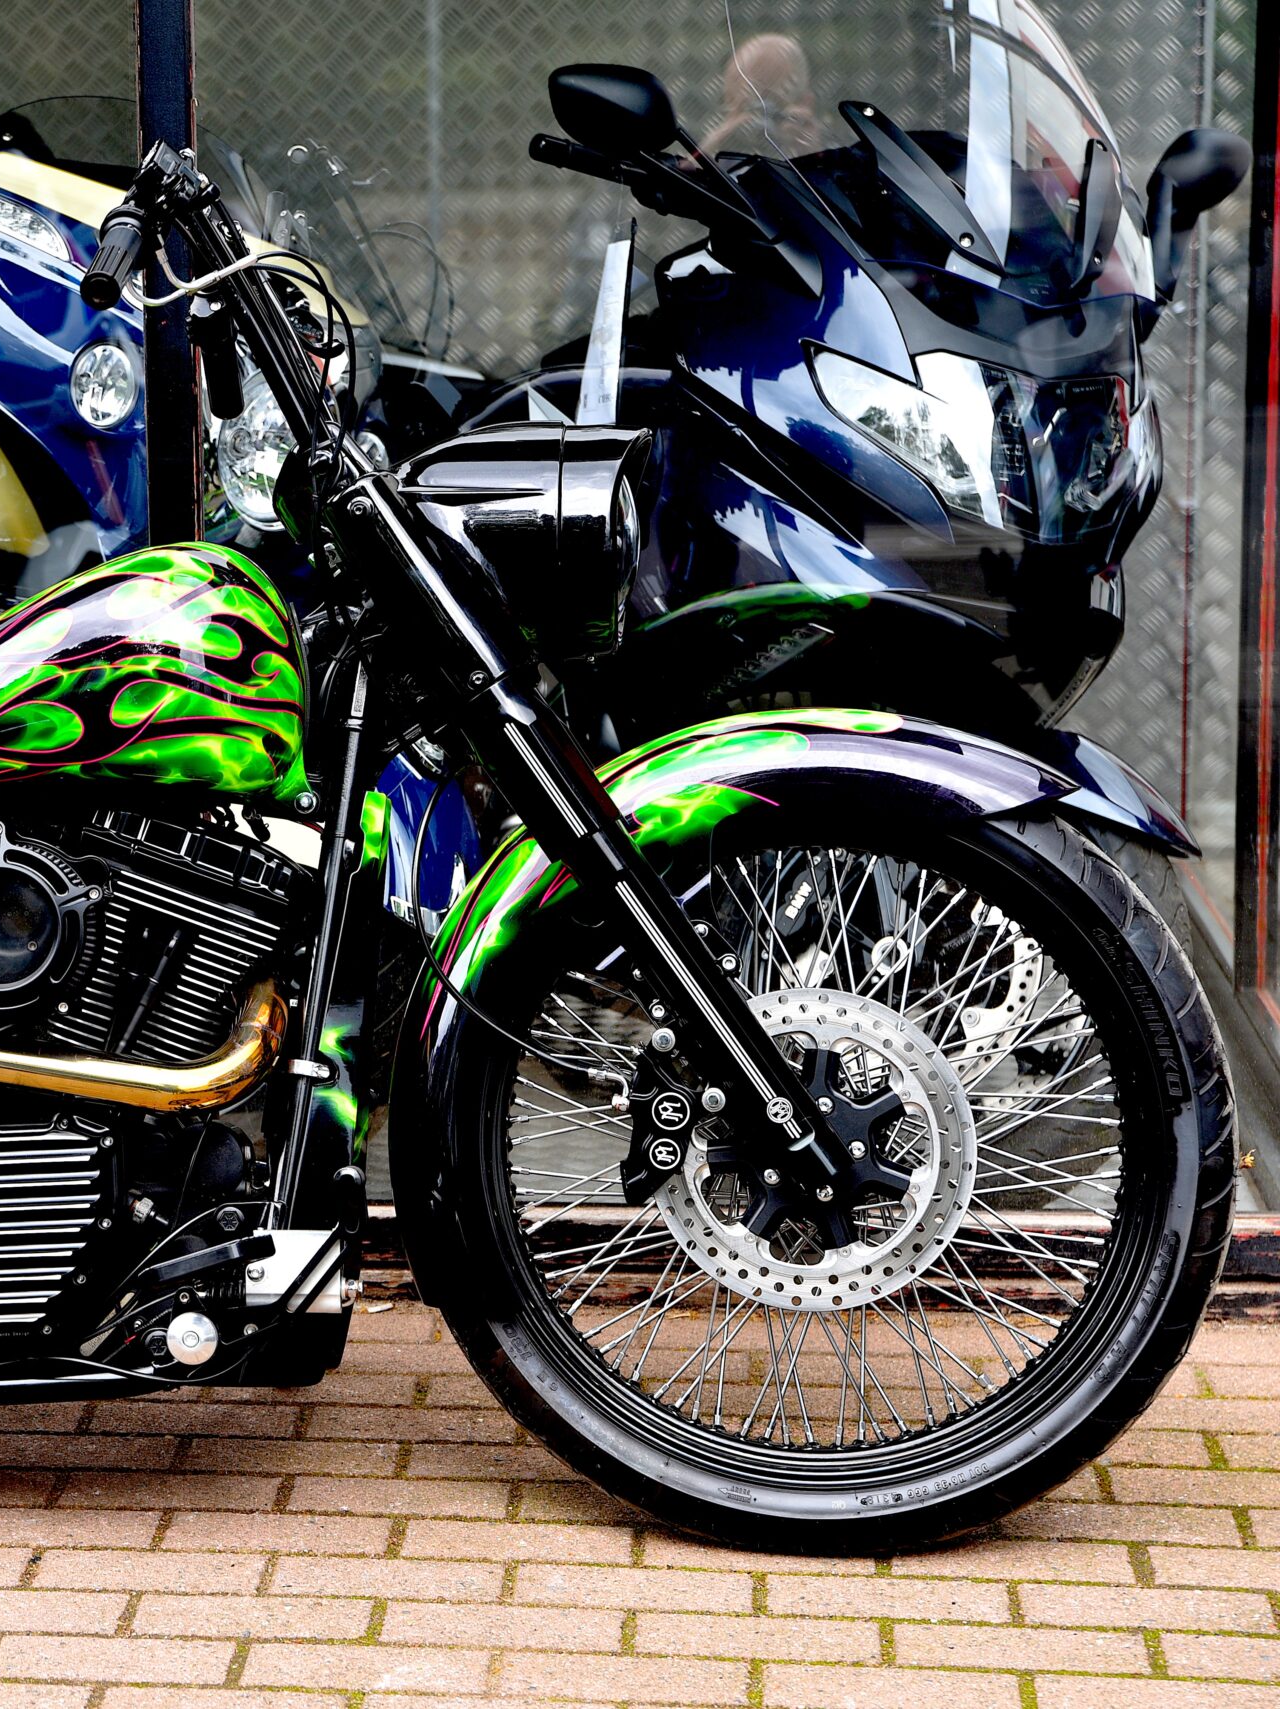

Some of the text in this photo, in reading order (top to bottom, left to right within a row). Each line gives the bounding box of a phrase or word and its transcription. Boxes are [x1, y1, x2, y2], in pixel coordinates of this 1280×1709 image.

[784, 881, 812, 920] BMW
[1125, 962, 1183, 1097] SHINKO
[969, 1463, 990, 1480] DOT
